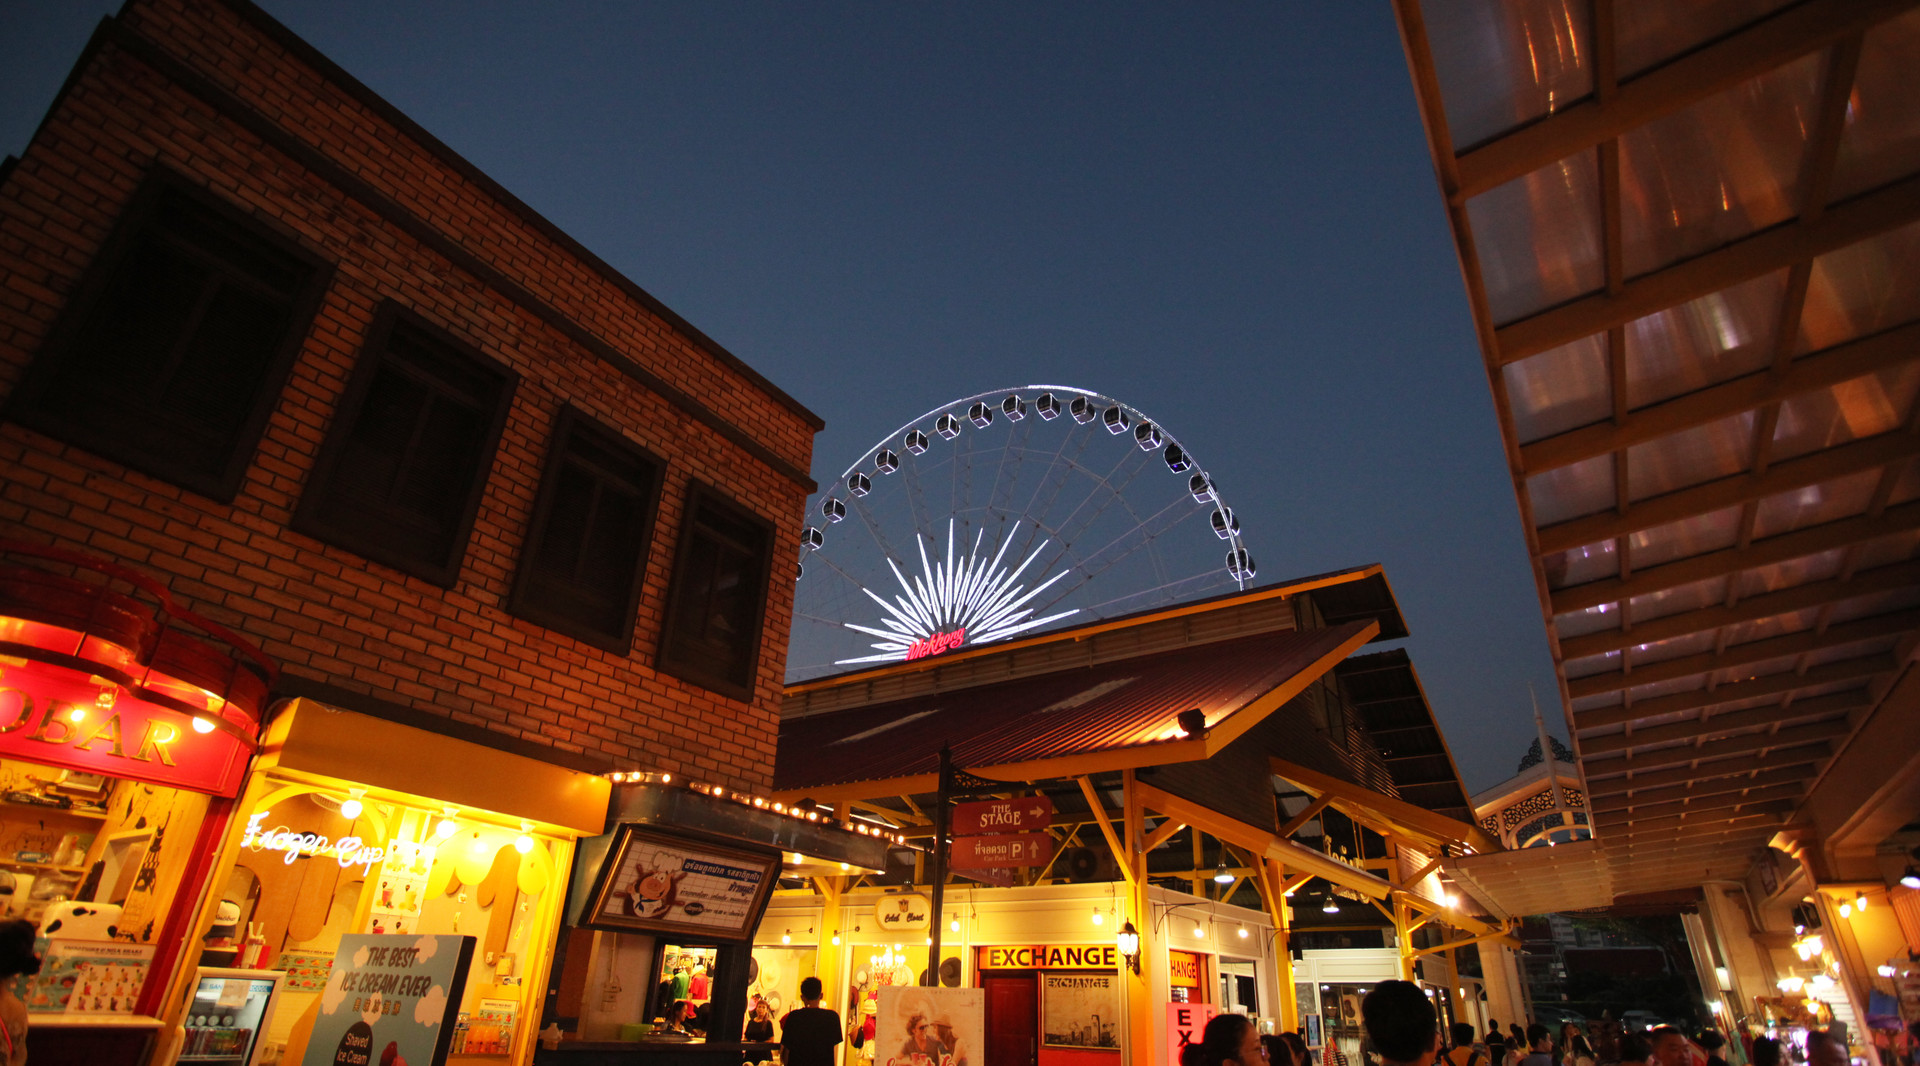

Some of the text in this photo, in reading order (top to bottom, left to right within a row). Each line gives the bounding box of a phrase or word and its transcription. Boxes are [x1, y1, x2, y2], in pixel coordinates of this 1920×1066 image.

[904, 628, 966, 661] Mekhong
[991, 804, 1011, 814] THE
[980, 811, 1021, 828] STAGE
[241, 811, 385, 877] Frozen Cup
[1012, 843, 1022, 858] P
[367, 946, 420, 968] THE BEST
[989, 947, 1116, 967] EXCHANGE
[340, 971, 432, 997] ICE CREAM EVER
[1047, 977, 1110, 989] EXCHANGE
[345, 1032, 369, 1048] Shaved
[336, 1049, 368, 1065] Ice Cream
